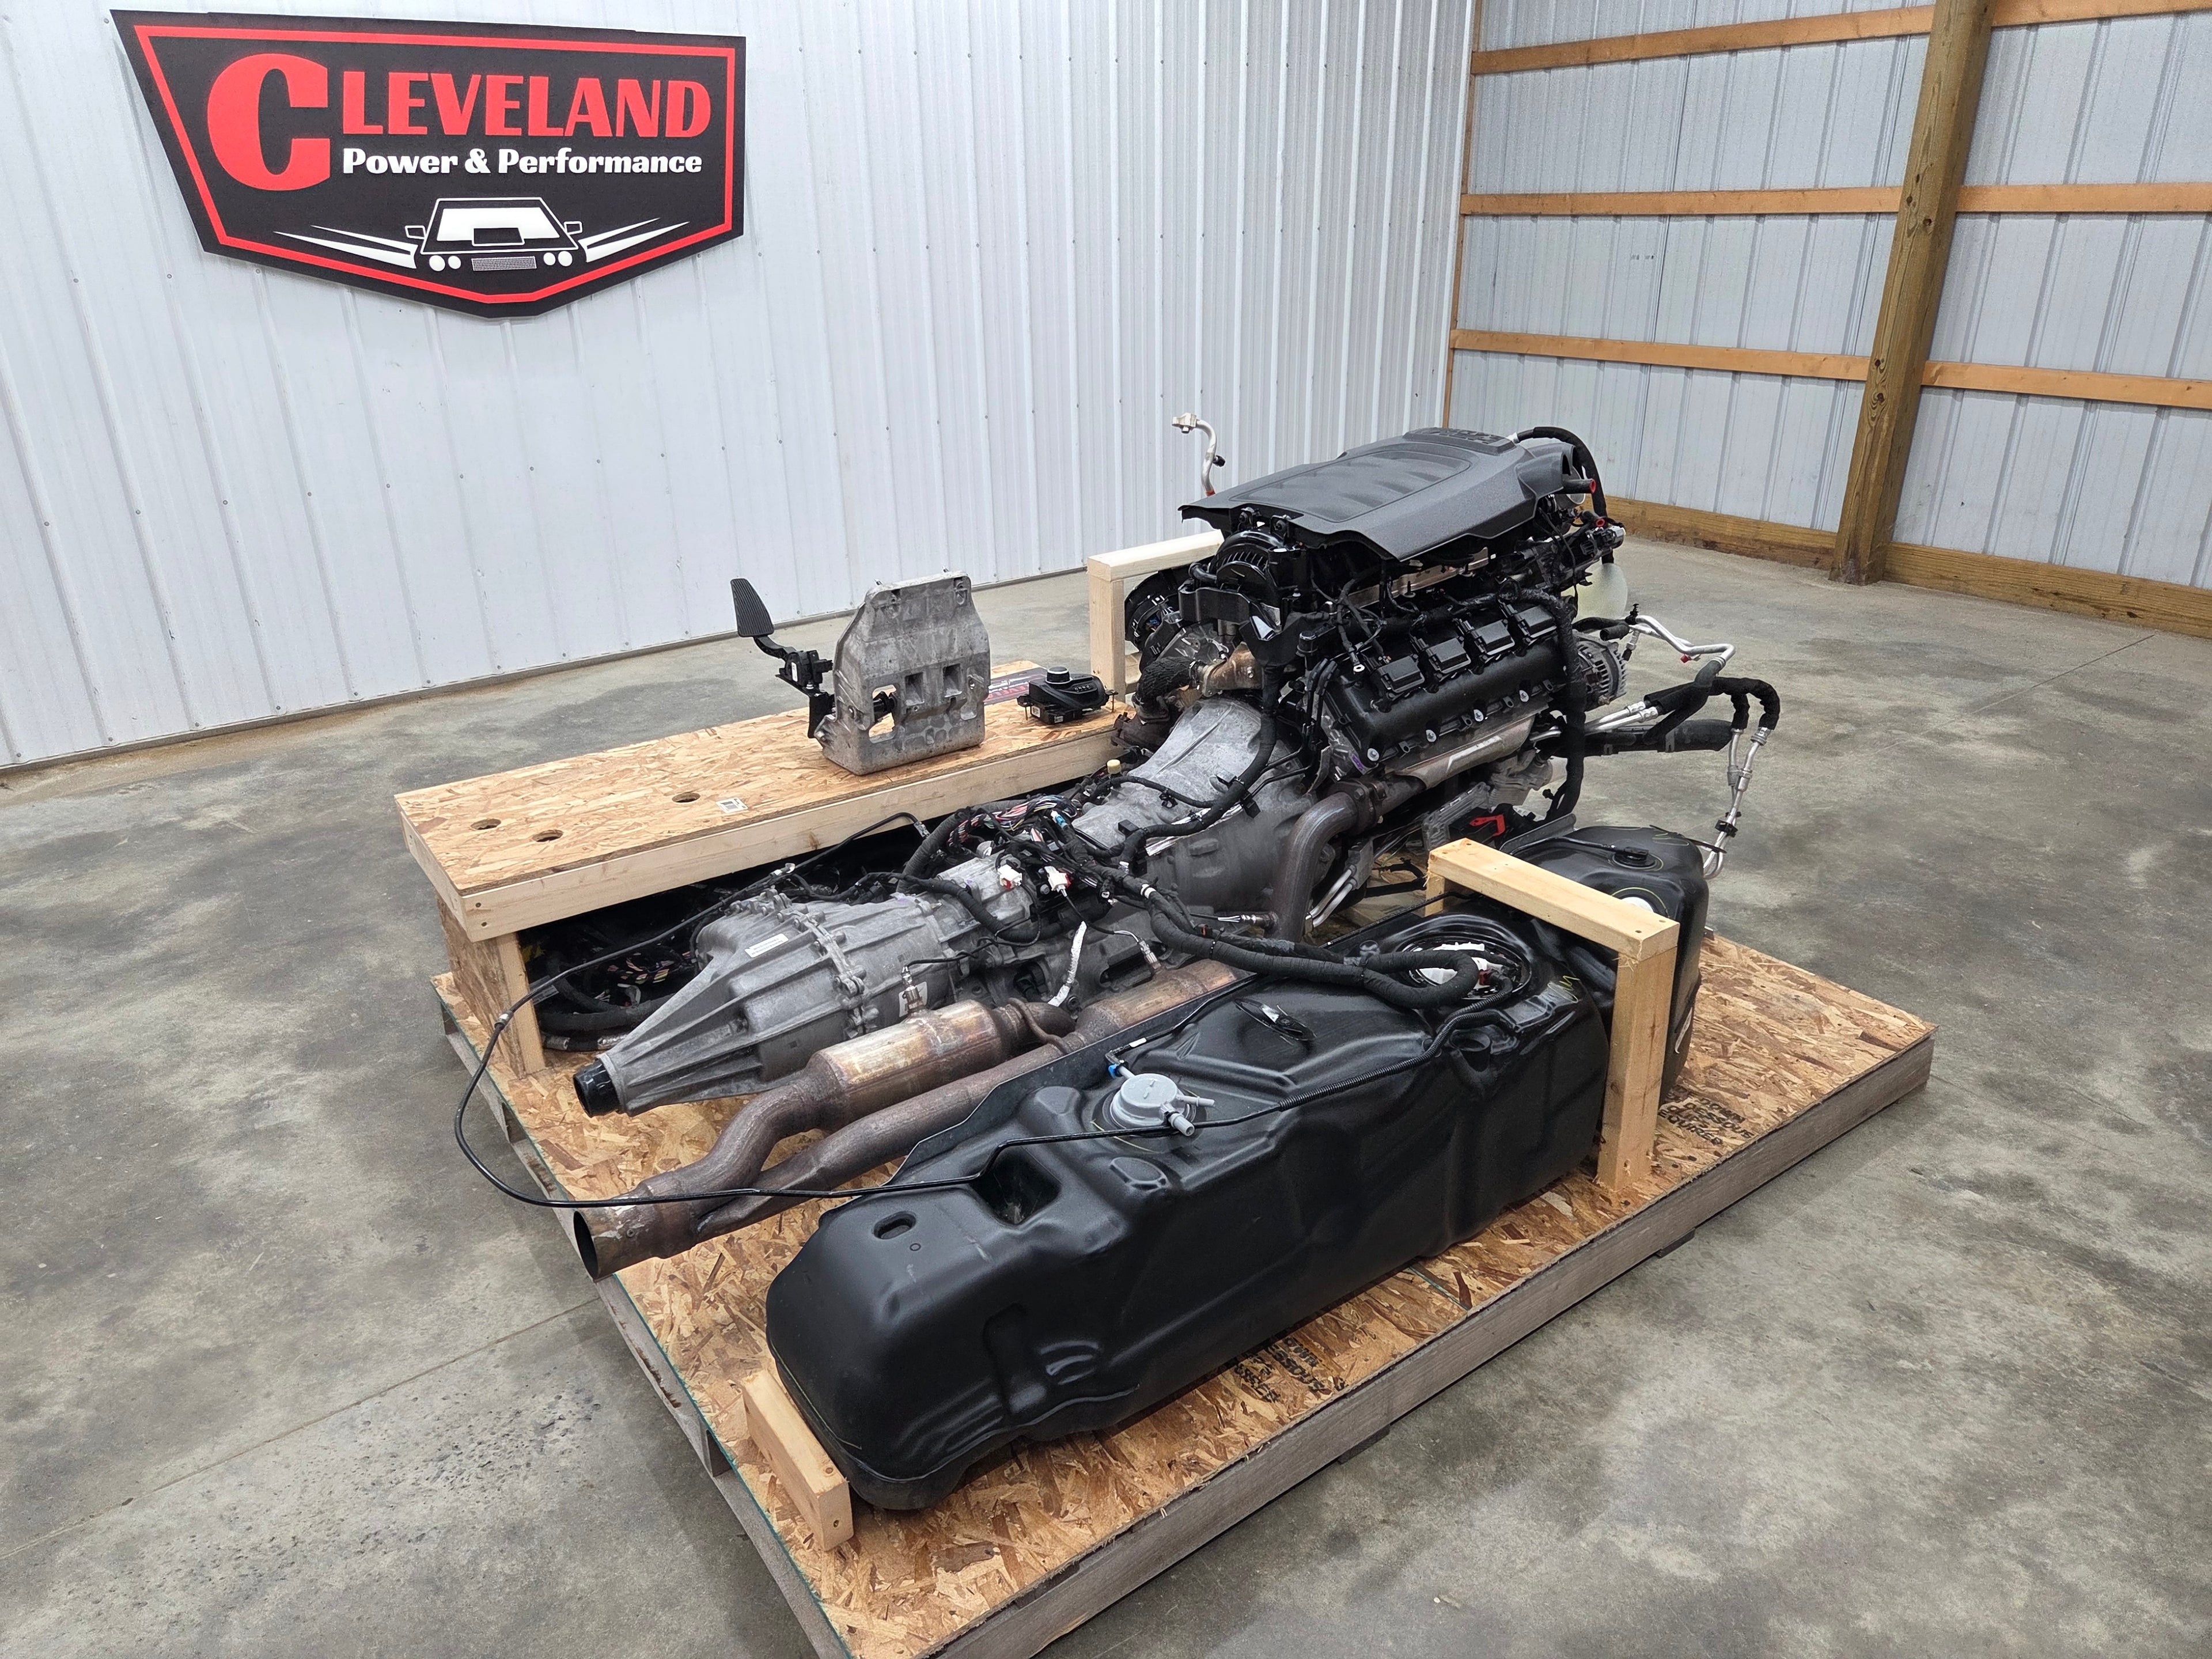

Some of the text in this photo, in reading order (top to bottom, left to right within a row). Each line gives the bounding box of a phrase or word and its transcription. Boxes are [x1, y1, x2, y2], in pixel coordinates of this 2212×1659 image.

[206, 52, 711, 191] CLEVELAND
[343, 147, 702, 174] Power & Performance
[1657, 1108, 1724, 1146] EQUIRED
